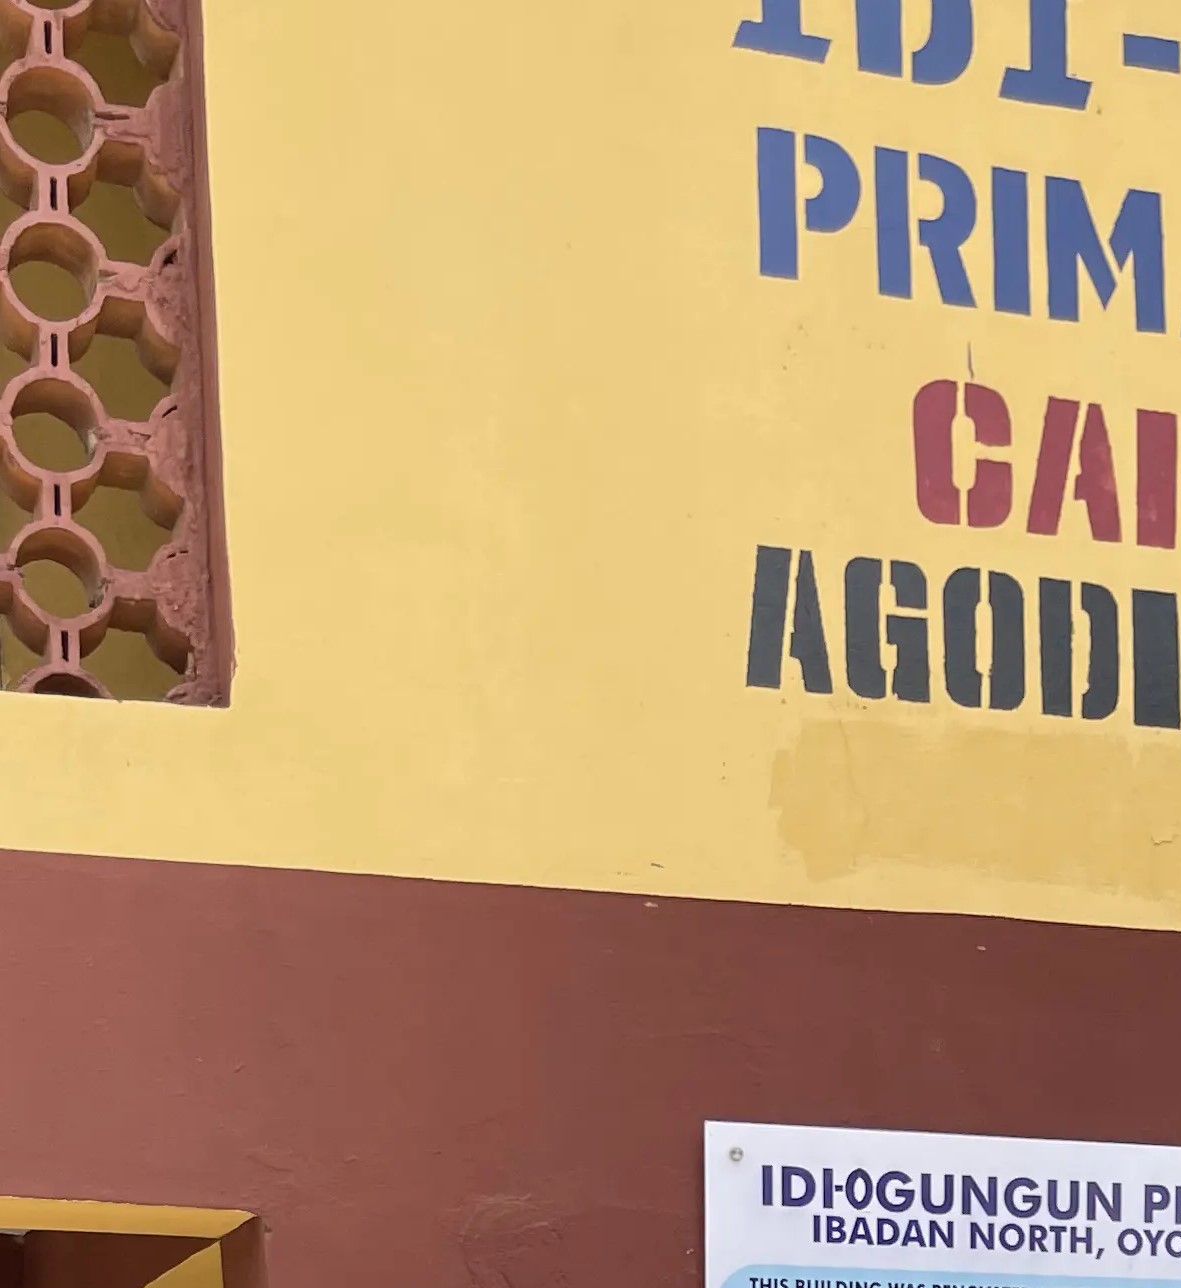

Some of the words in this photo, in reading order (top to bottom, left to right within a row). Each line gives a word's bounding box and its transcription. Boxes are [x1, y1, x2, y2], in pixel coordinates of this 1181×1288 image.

[745, 544, 1181, 730] AGODI
[761, 1164, 1122, 1222] IDI-OGUNGUN
[813, 1214, 954, 1249] IBADAN
[970, 1222, 1105, 1260] NORTH,
